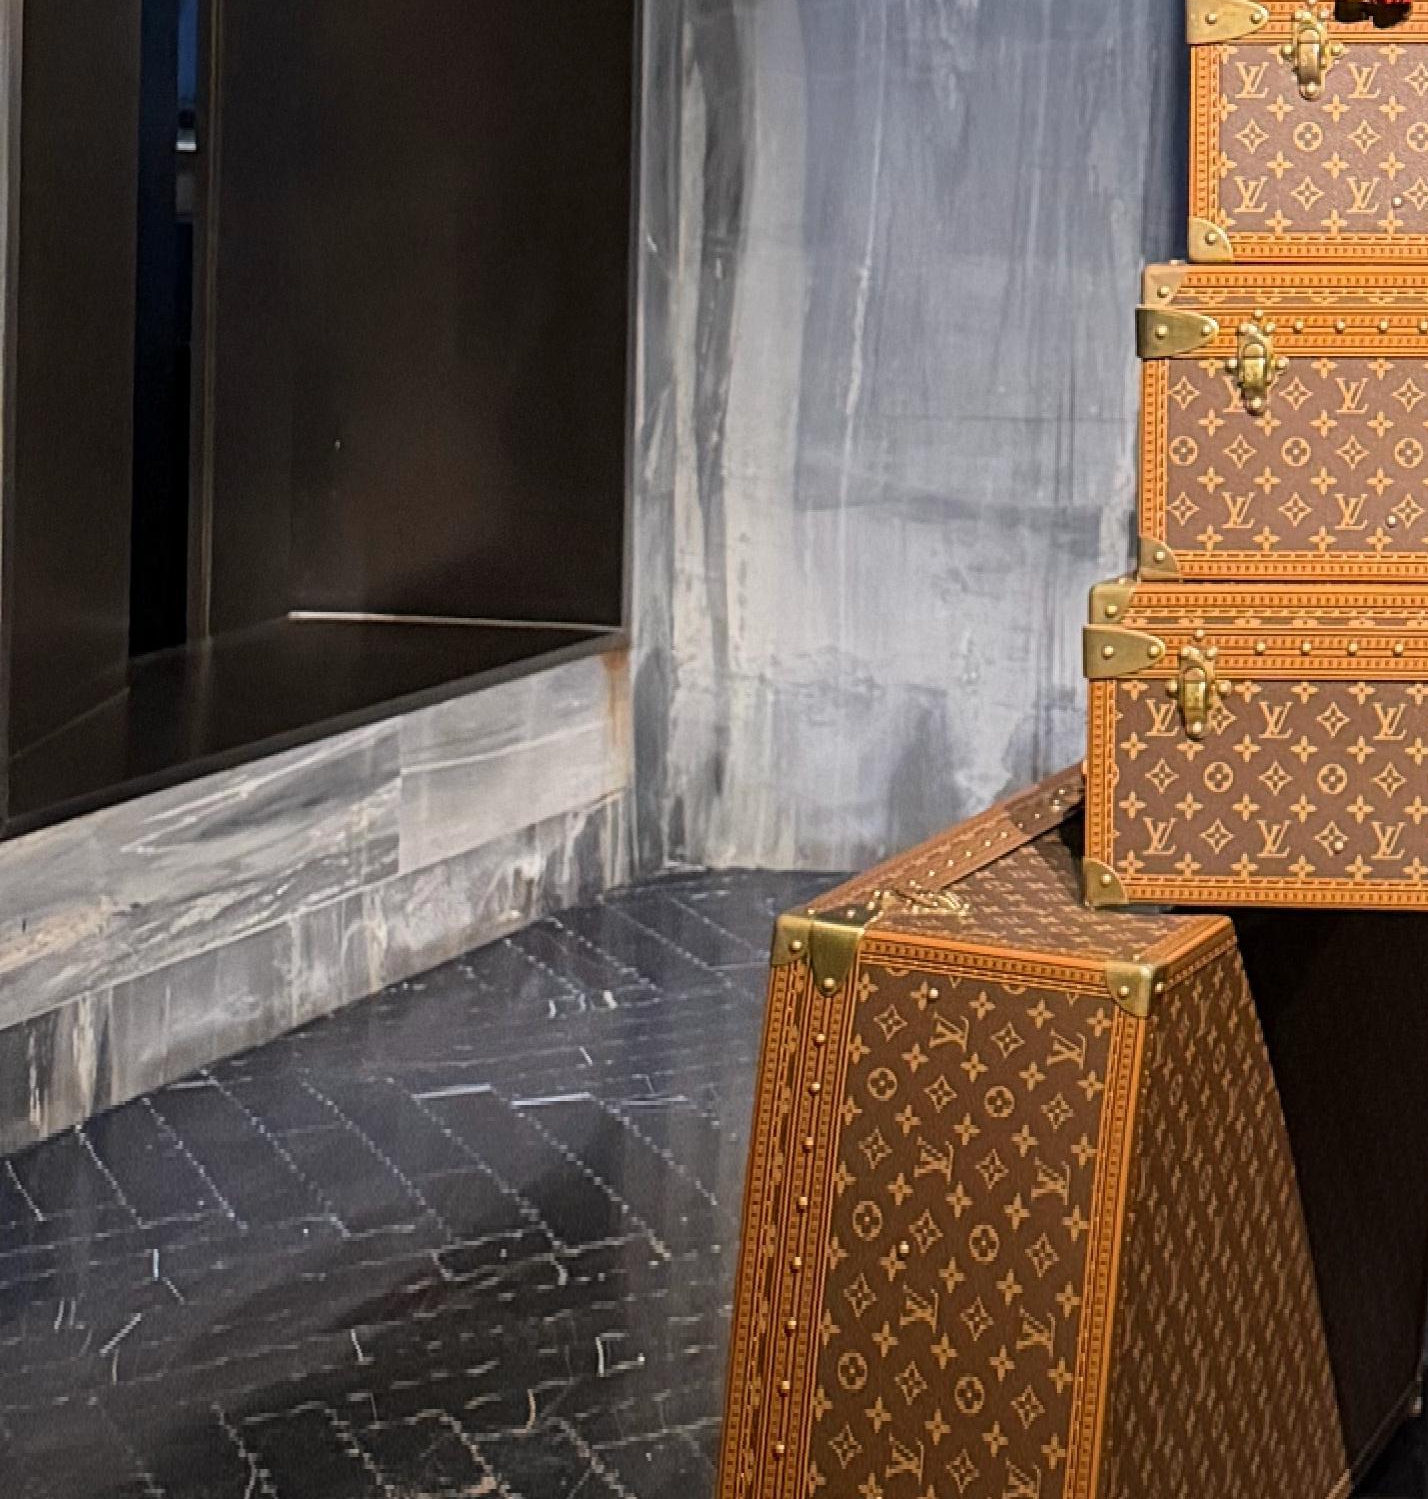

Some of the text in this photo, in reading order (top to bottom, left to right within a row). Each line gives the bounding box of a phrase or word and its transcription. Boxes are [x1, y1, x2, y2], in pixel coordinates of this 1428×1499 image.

[1235, 63, 1269, 98] LV
[1347, 63, 1380, 98] LV
[1235, 177, 1268, 213] LV
[1346, 177, 1379, 213] LV
[1335, 378, 1369, 413] LV
[1222, 492, 1255, 529] LV
[1334, 494, 1368, 530] LV
[1144, 699, 1179, 737] LV
[1258, 700, 1294, 739] LV
[1373, 703, 1407, 741] LV
[1143, 817, 1177, 856] LV
[1257, 819, 1293, 857] LV
[1370, 822, 1406, 859] LV
